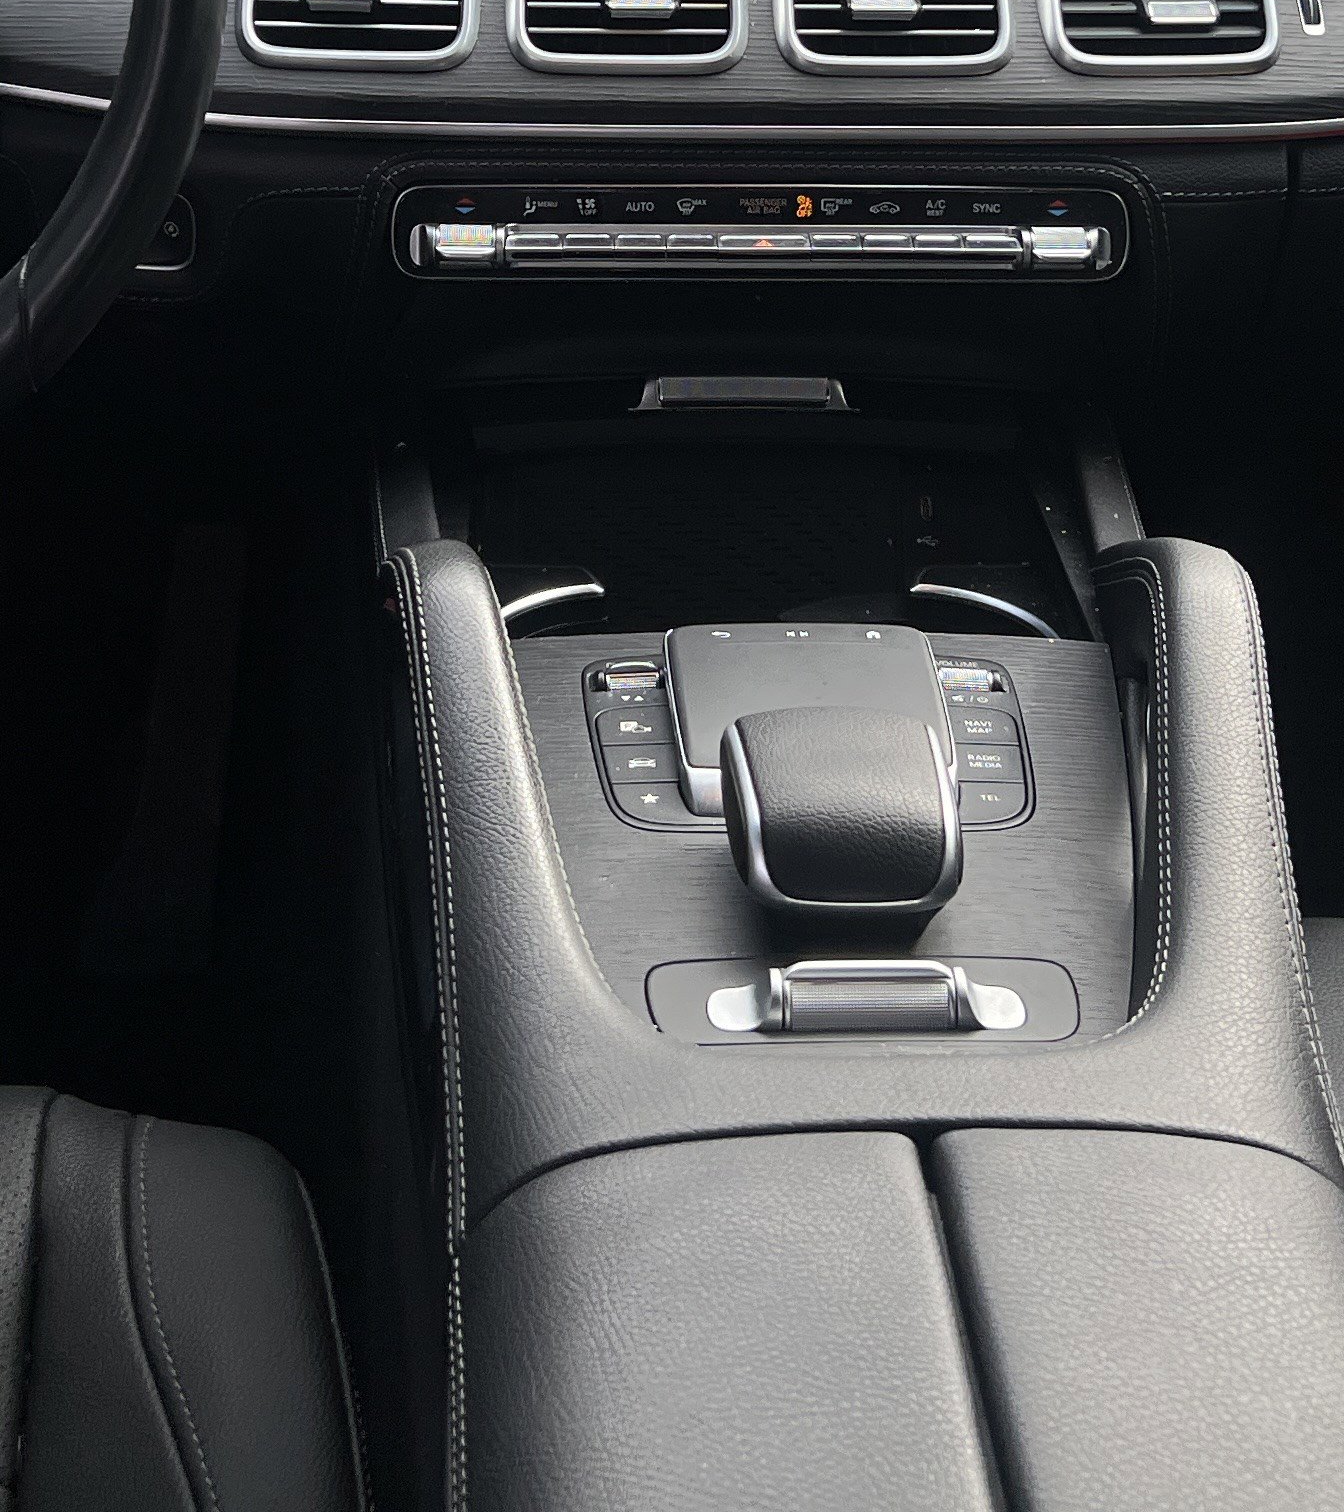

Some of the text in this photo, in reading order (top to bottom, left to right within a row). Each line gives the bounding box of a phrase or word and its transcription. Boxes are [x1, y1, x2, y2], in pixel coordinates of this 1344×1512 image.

[537, 200, 559, 208] MENU
[692, 199, 707, 207] MAX
[739, 198, 788, 207] PASSENGER
[835, 198, 853, 206] REAR
[925, 199, 946, 209] A/C
[625, 201, 655, 213] AUTO
[746, 206, 781, 215] AIR BAG
[972, 202, 1001, 214] SYNC
[584, 208, 597, 216] OFF
[796, 208, 813, 218] OFF
[926, 208, 944, 216] REST
[935, 660, 979, 668] VOLUME
[964, 719, 993, 727] NAVI
[966, 726, 993, 734] MAP
[968, 761, 1003, 769] MEDIA
[980, 794, 1001, 802] TEL
